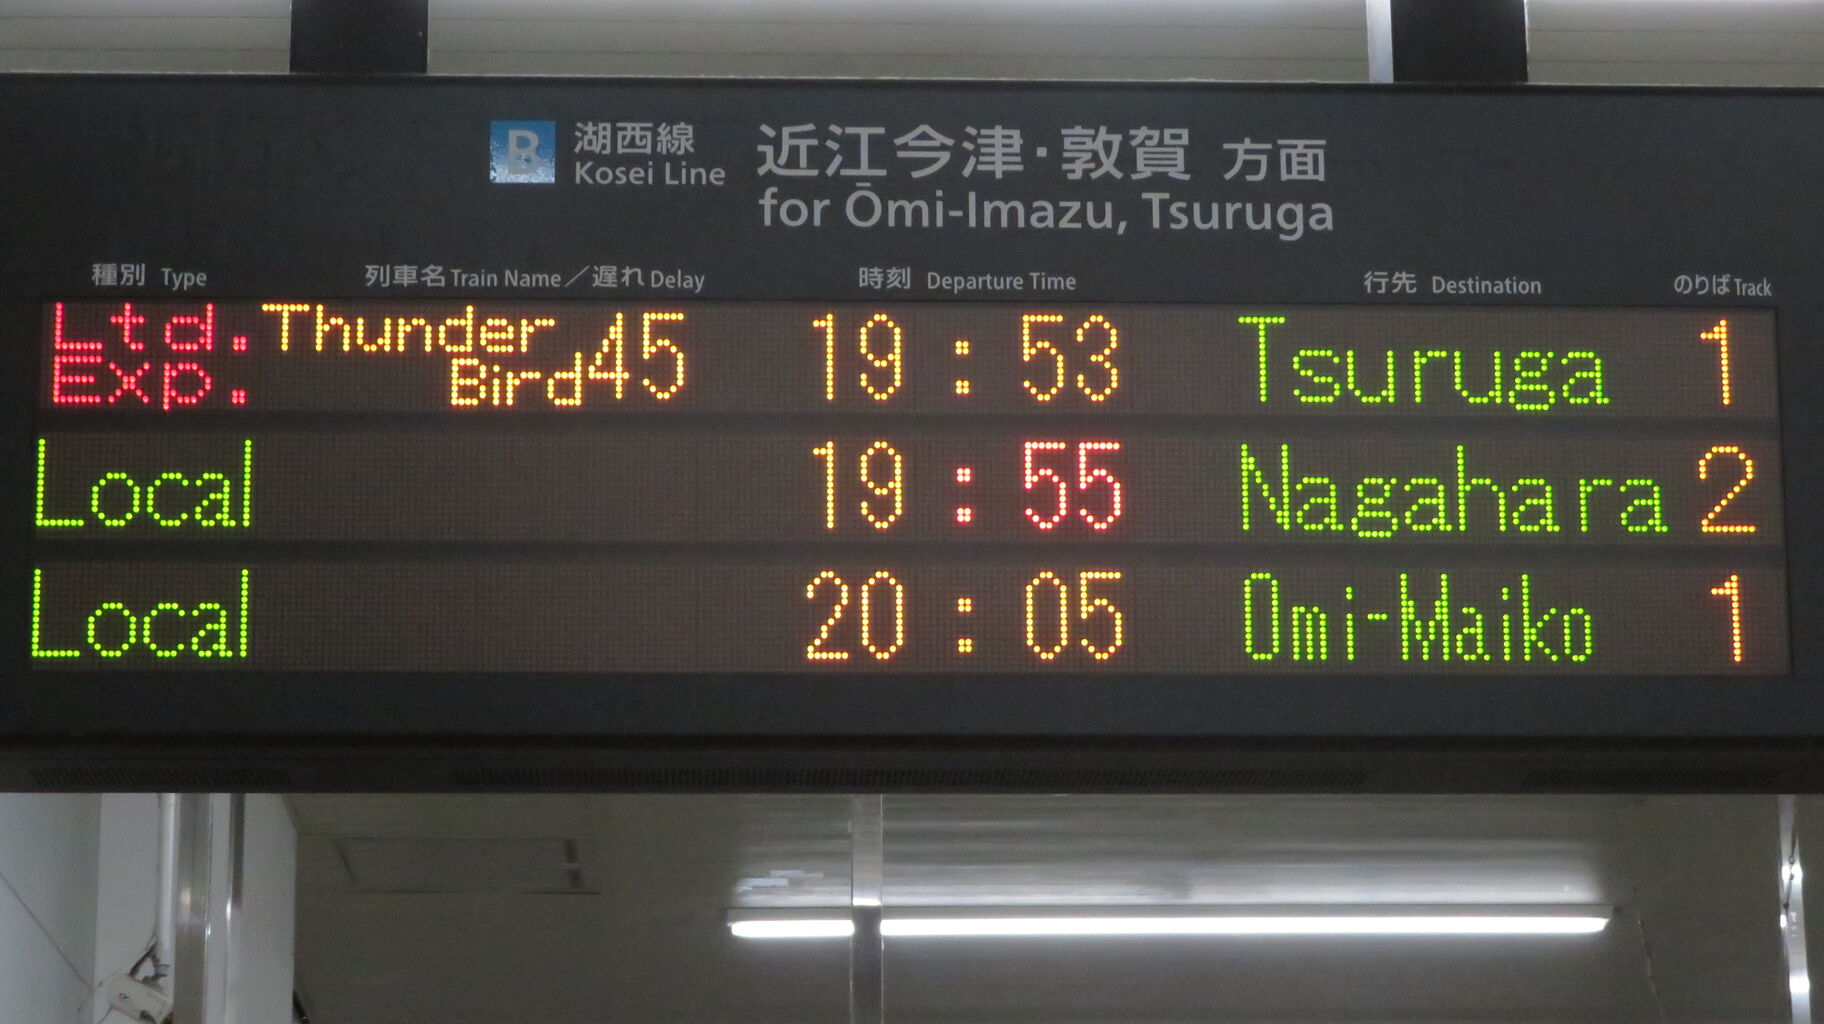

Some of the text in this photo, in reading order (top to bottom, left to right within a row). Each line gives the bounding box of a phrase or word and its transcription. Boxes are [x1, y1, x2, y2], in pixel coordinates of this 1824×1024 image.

[507, 129, 539, 174] B
[574, 121, 695, 155] 湖西線
[1222, 137, 1327, 182] 方面
[575, 161, 726, 185] Kosei Line
[759, 182, 1334, 241] for Ōmi-Imazu, Tsuruga
[92, 263, 207, 290] 種別 Type
[365, 264, 446, 287] 列車名
[451, 269, 498, 287] Train
[651, 269, 705, 293] Delay
[859, 266, 1077, 294] 時刻 Departure Time
[1364, 271, 1543, 294] 行先 Destination
[1674, 274, 1773, 297] のりば Track
[54, 302, 248, 352] Ltd.
[262, 303, 556, 352] Thunder
[53, 354, 247, 411] Exp.
[451, 351, 583, 407] Bird
[588, 312, 686, 401] 45
[1239, 316, 1610, 411] Tsuruga
[1700, 318, 1731, 406] 1
[36, 438, 252, 528] Local
[1240, 443, 1669, 538] Nagahara
[1698, 445, 1757, 534] 2
[31, 568, 249, 658] Local
[1244, 572, 1594, 662] Omi-Maiko
[1710, 574, 1743, 663] 1
